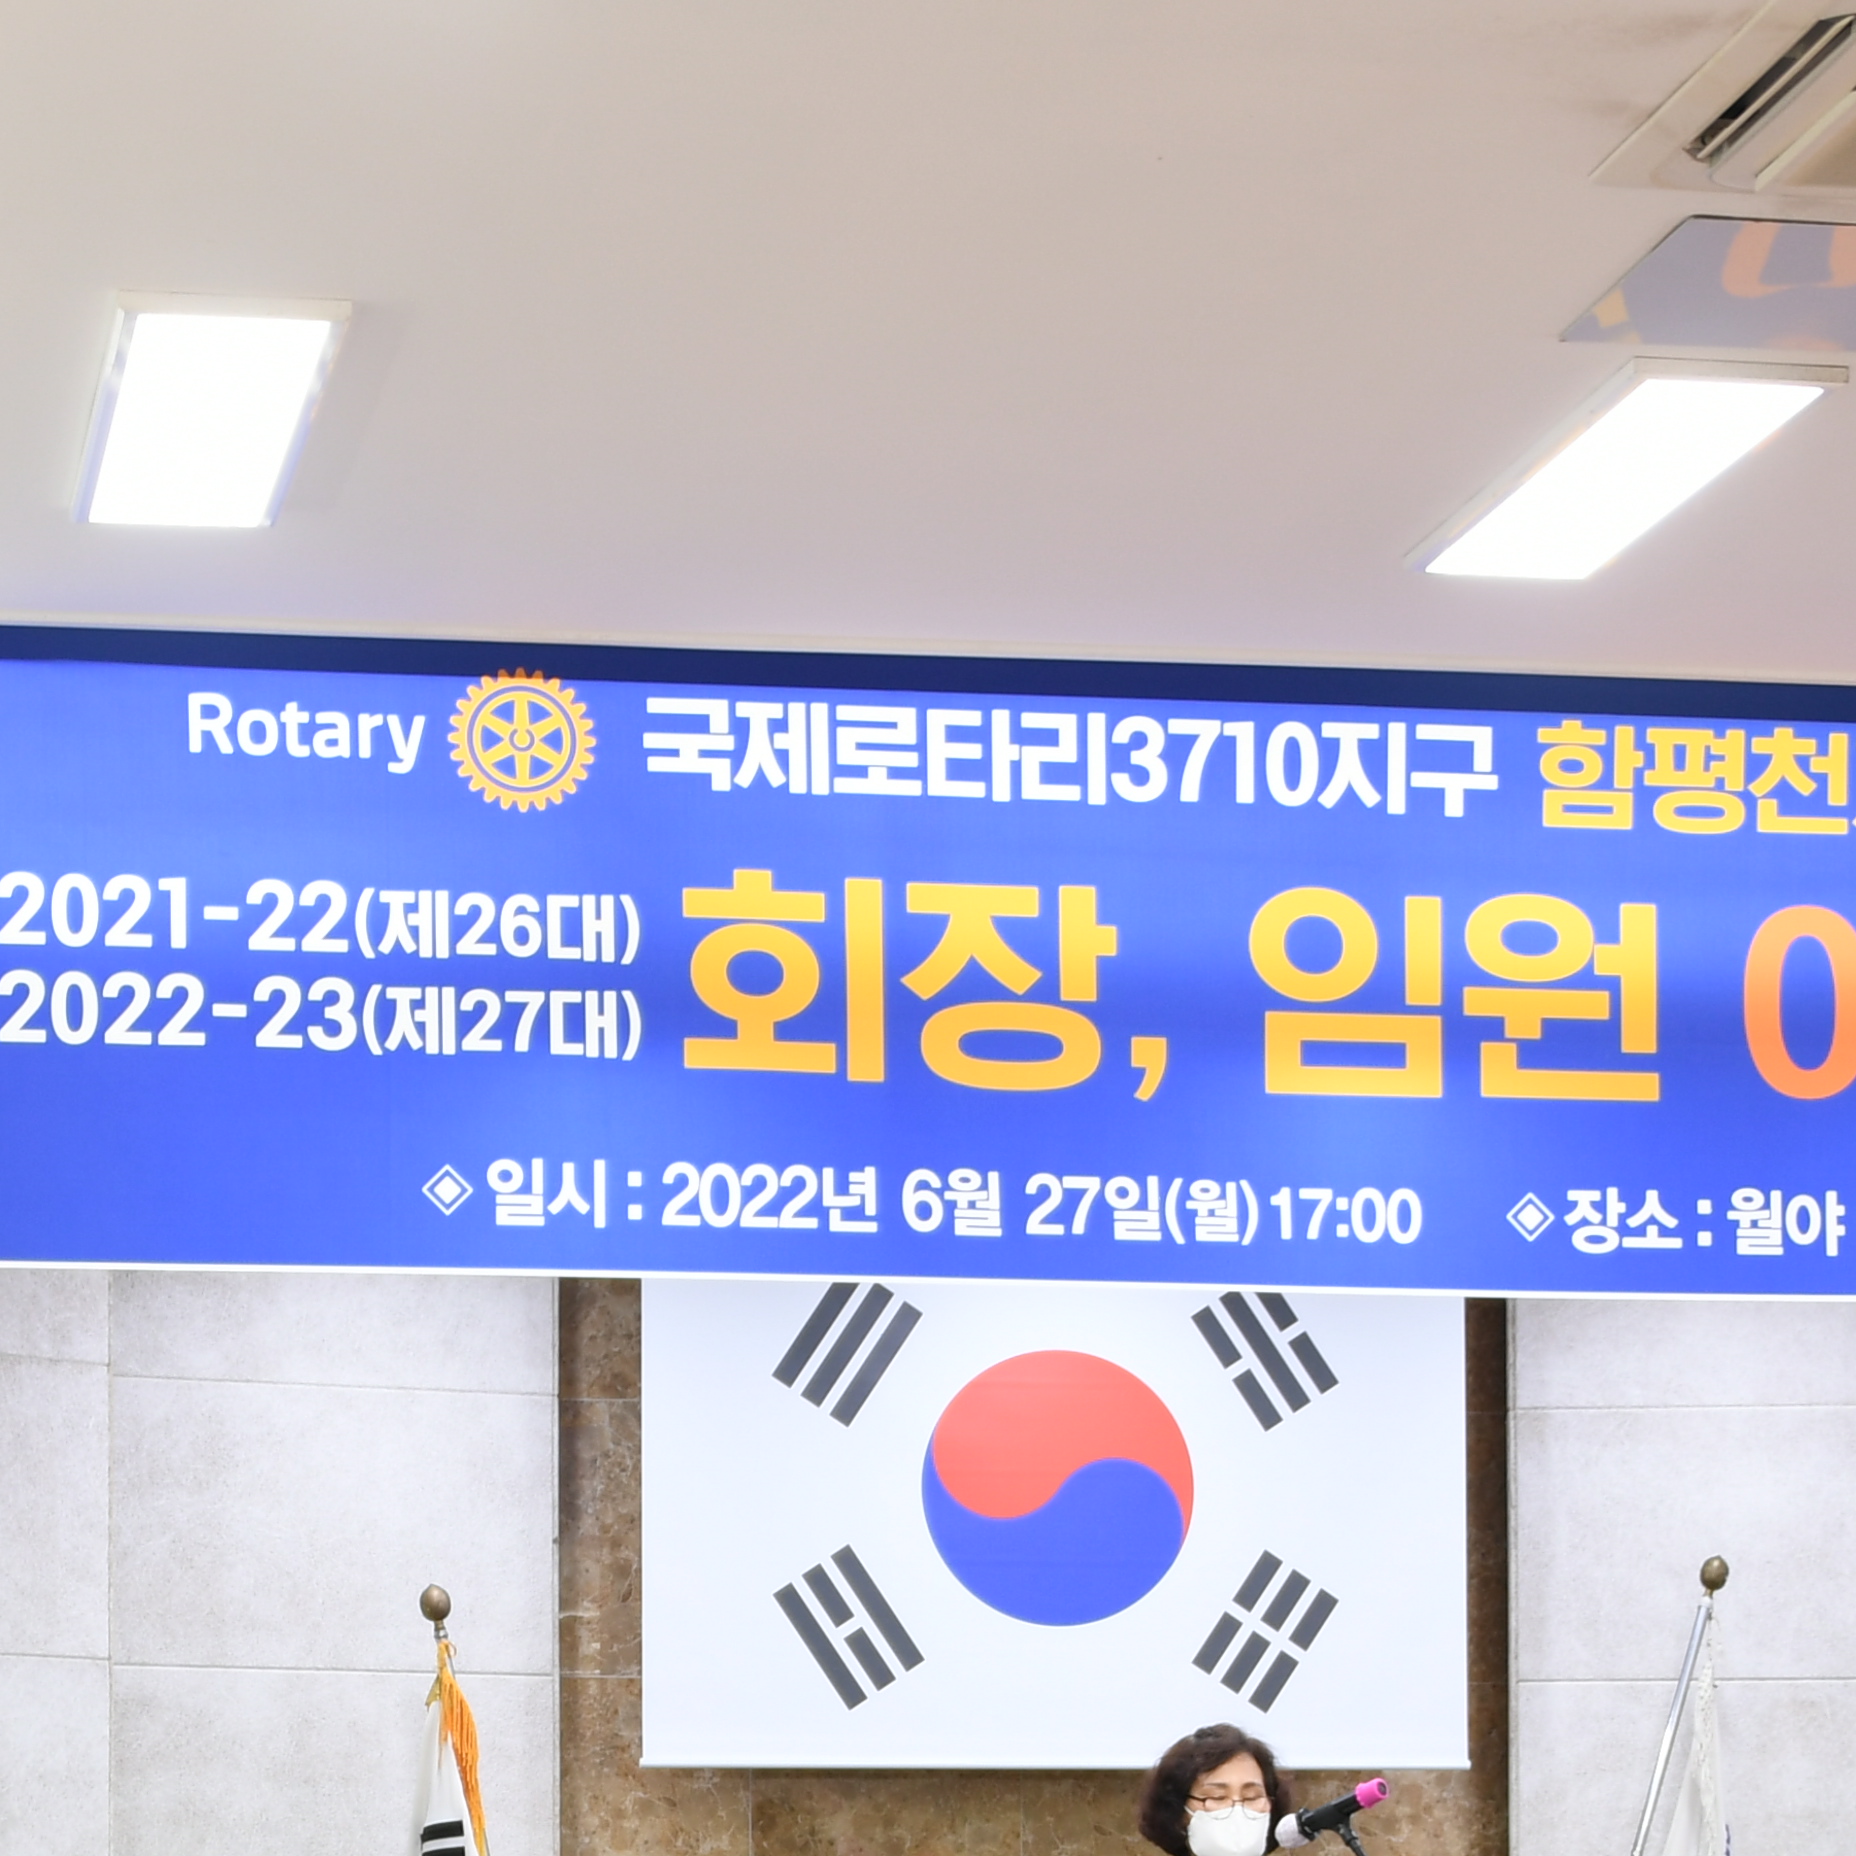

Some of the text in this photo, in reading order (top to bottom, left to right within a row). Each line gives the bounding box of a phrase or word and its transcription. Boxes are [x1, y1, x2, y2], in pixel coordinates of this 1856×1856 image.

[188, 692, 425, 773] Rotary
[643, 697, 1498, 817] 국제로타리3710지구
[682, 868, 1167, 1101] 회장,
[1249, 886, 1660, 1101] 임원
[660, 1161, 878, 1235] 2022년
[901, 1167, 1003, 1239] 6월
[1726, 1187, 1846, 1257] 월야
